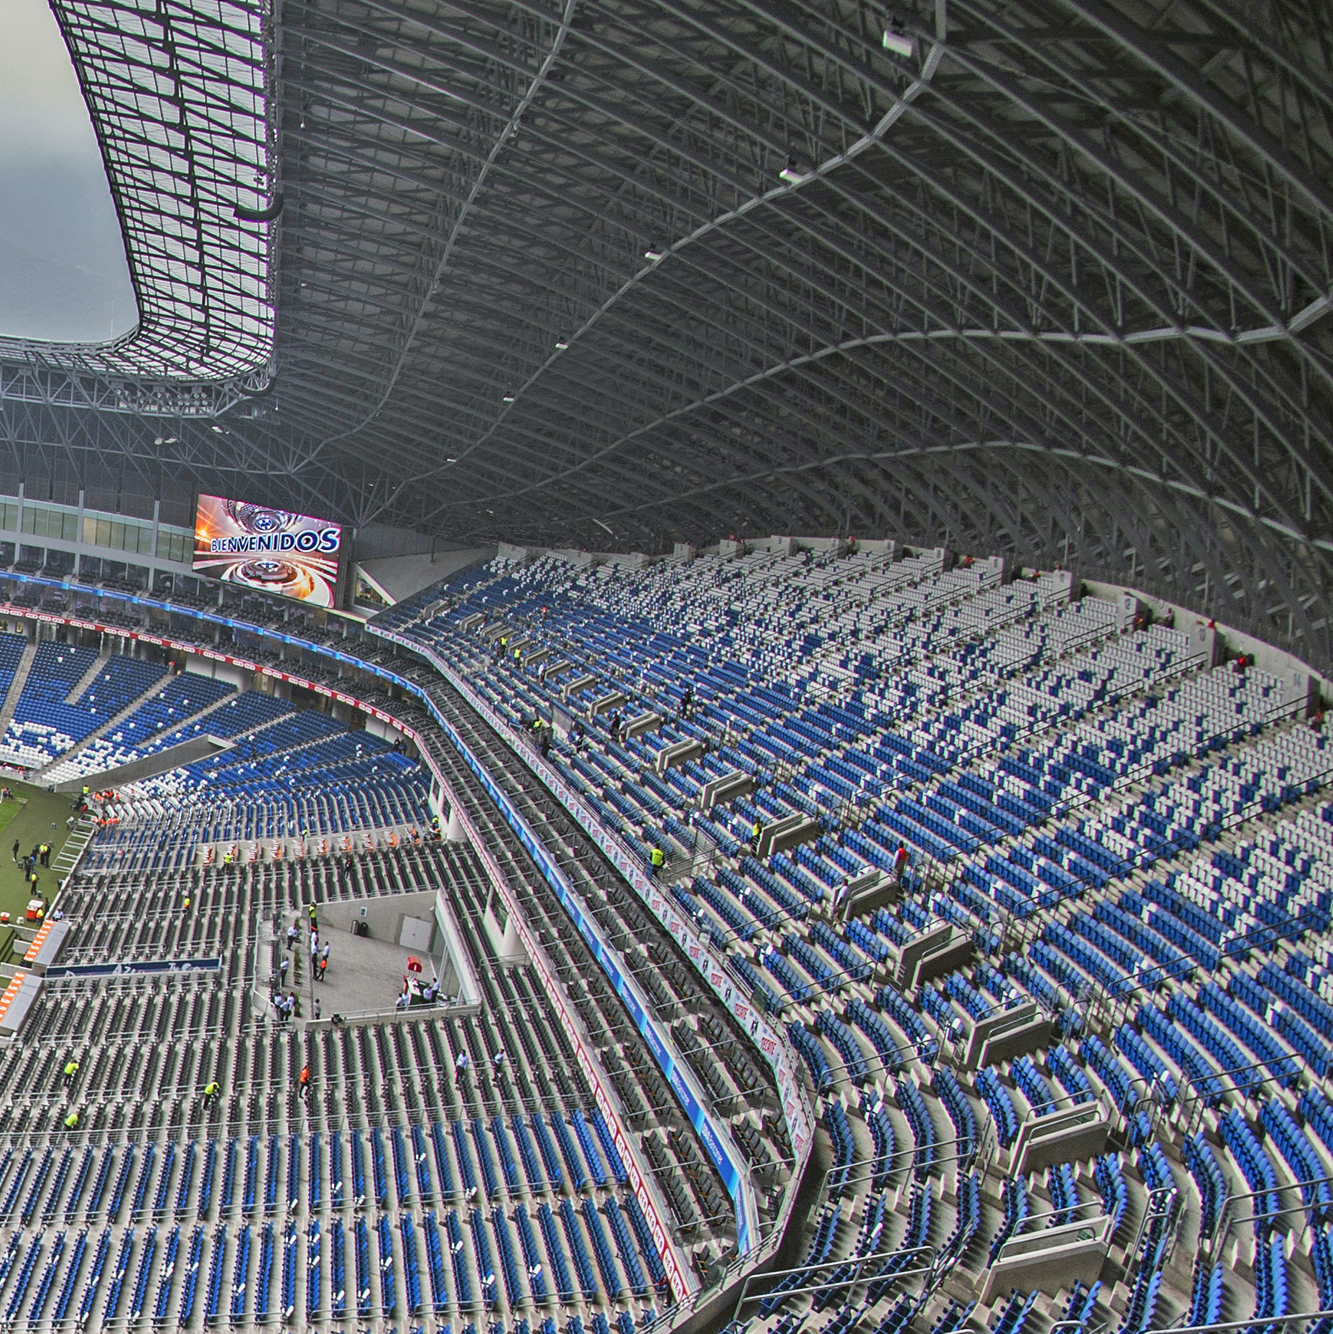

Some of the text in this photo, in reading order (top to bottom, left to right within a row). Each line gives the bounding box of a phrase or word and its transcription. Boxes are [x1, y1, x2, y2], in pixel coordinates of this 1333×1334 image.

[211, 528, 341, 553] BIENVENIDOS
[735, 1003, 748, 1020] TECATE
[761, 1037, 776, 1055] TECATE
